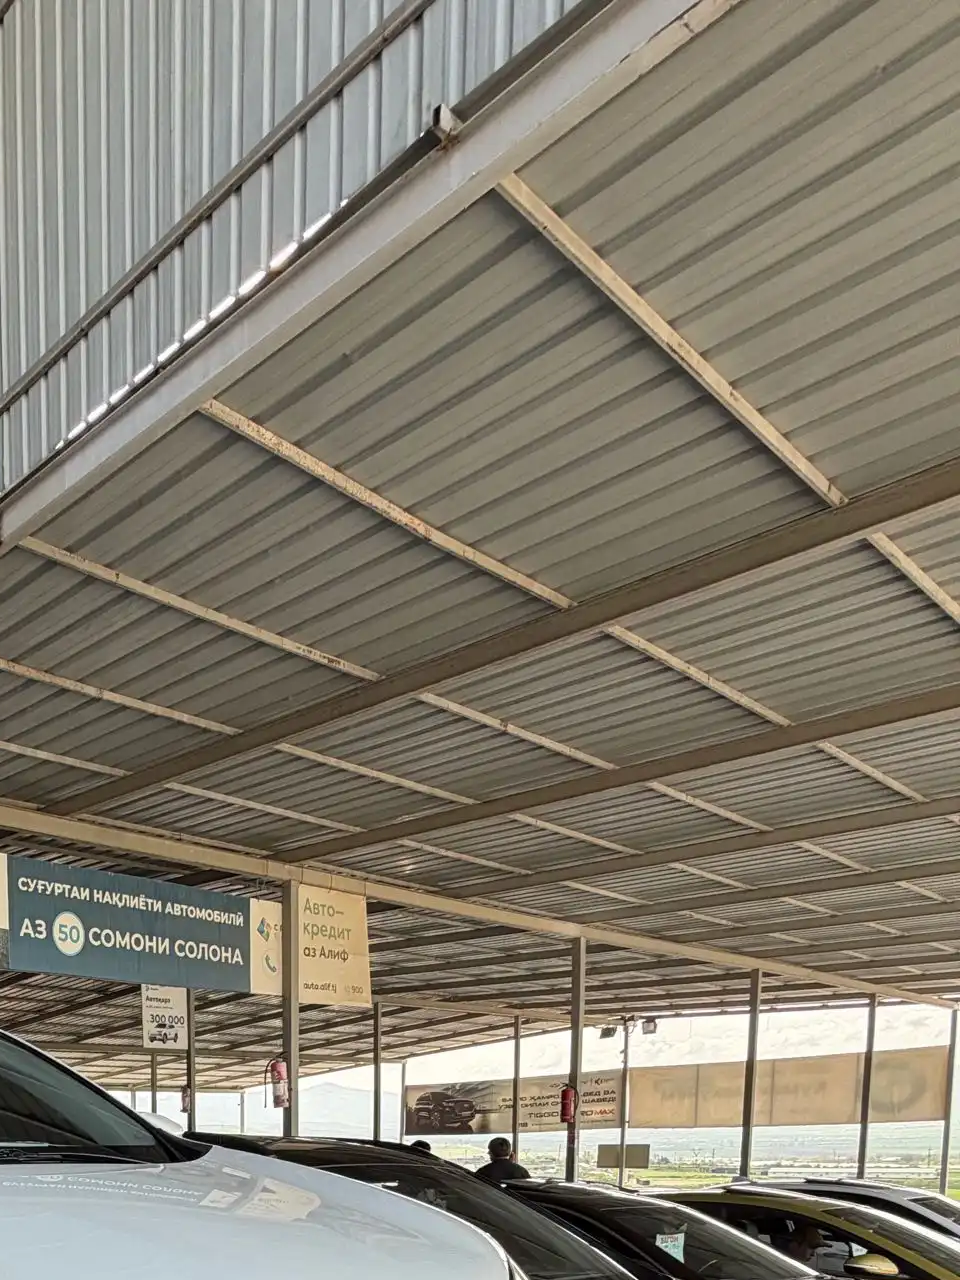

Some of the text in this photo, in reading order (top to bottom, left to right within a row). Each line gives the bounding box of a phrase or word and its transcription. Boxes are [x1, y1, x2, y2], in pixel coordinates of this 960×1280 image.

[18, 876, 90, 901] СУҒУРТАИ
[93, 889, 162, 913] НАҚЛИЁТИ
[303, 922, 352, 941] кредит
[20, 918, 244, 965] АЗ 50 СОМОНИ СОЛОНА
[303, 945, 349, 963] аз Алиф
[303, 981, 337, 994] auto.alif.tj
[150, 1014, 185, 1025] 300 000
[594, 1108, 615, 1116] MAX
